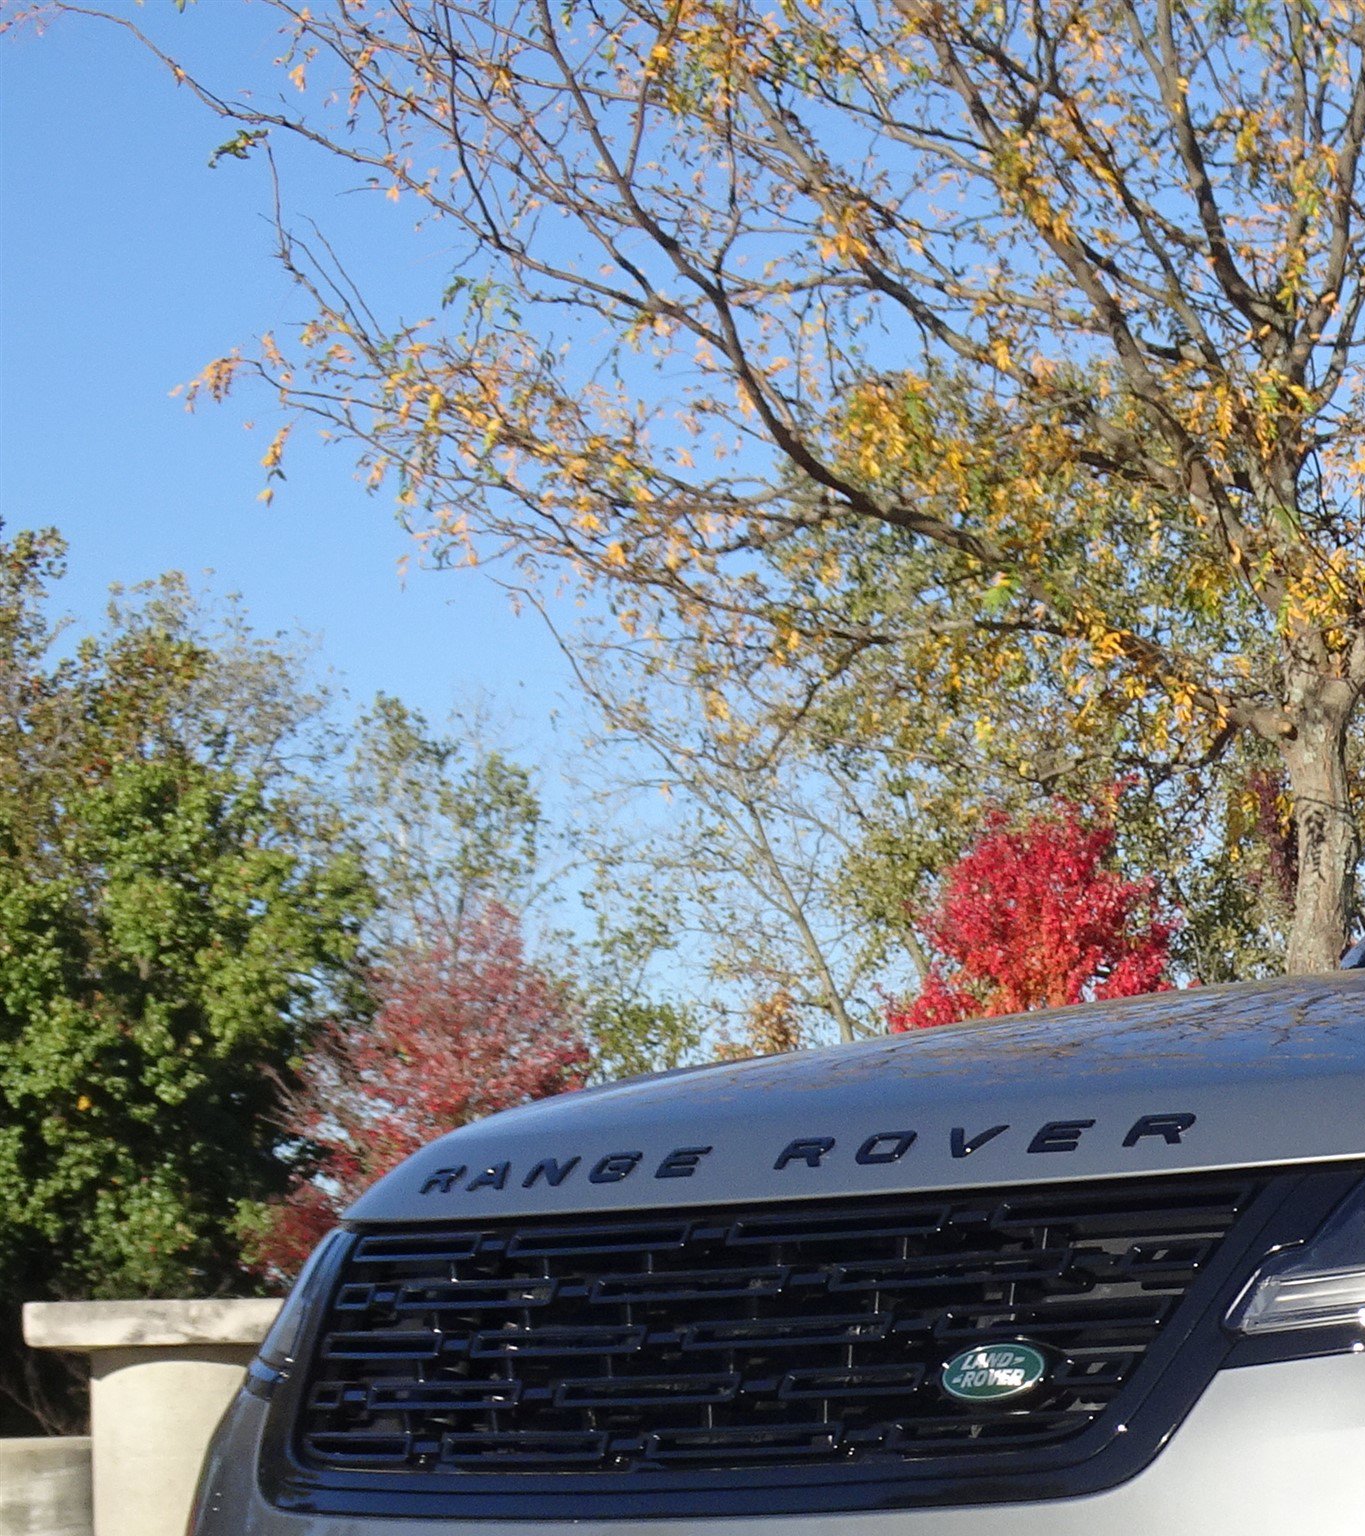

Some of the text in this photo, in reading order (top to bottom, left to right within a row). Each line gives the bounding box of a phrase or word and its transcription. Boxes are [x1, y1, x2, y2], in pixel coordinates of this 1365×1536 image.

[418, 1111, 1197, 1195] RANGE ROVER
[960, 1352, 1015, 1371] LAND
[959, 1368, 1026, 1388] ROVER
